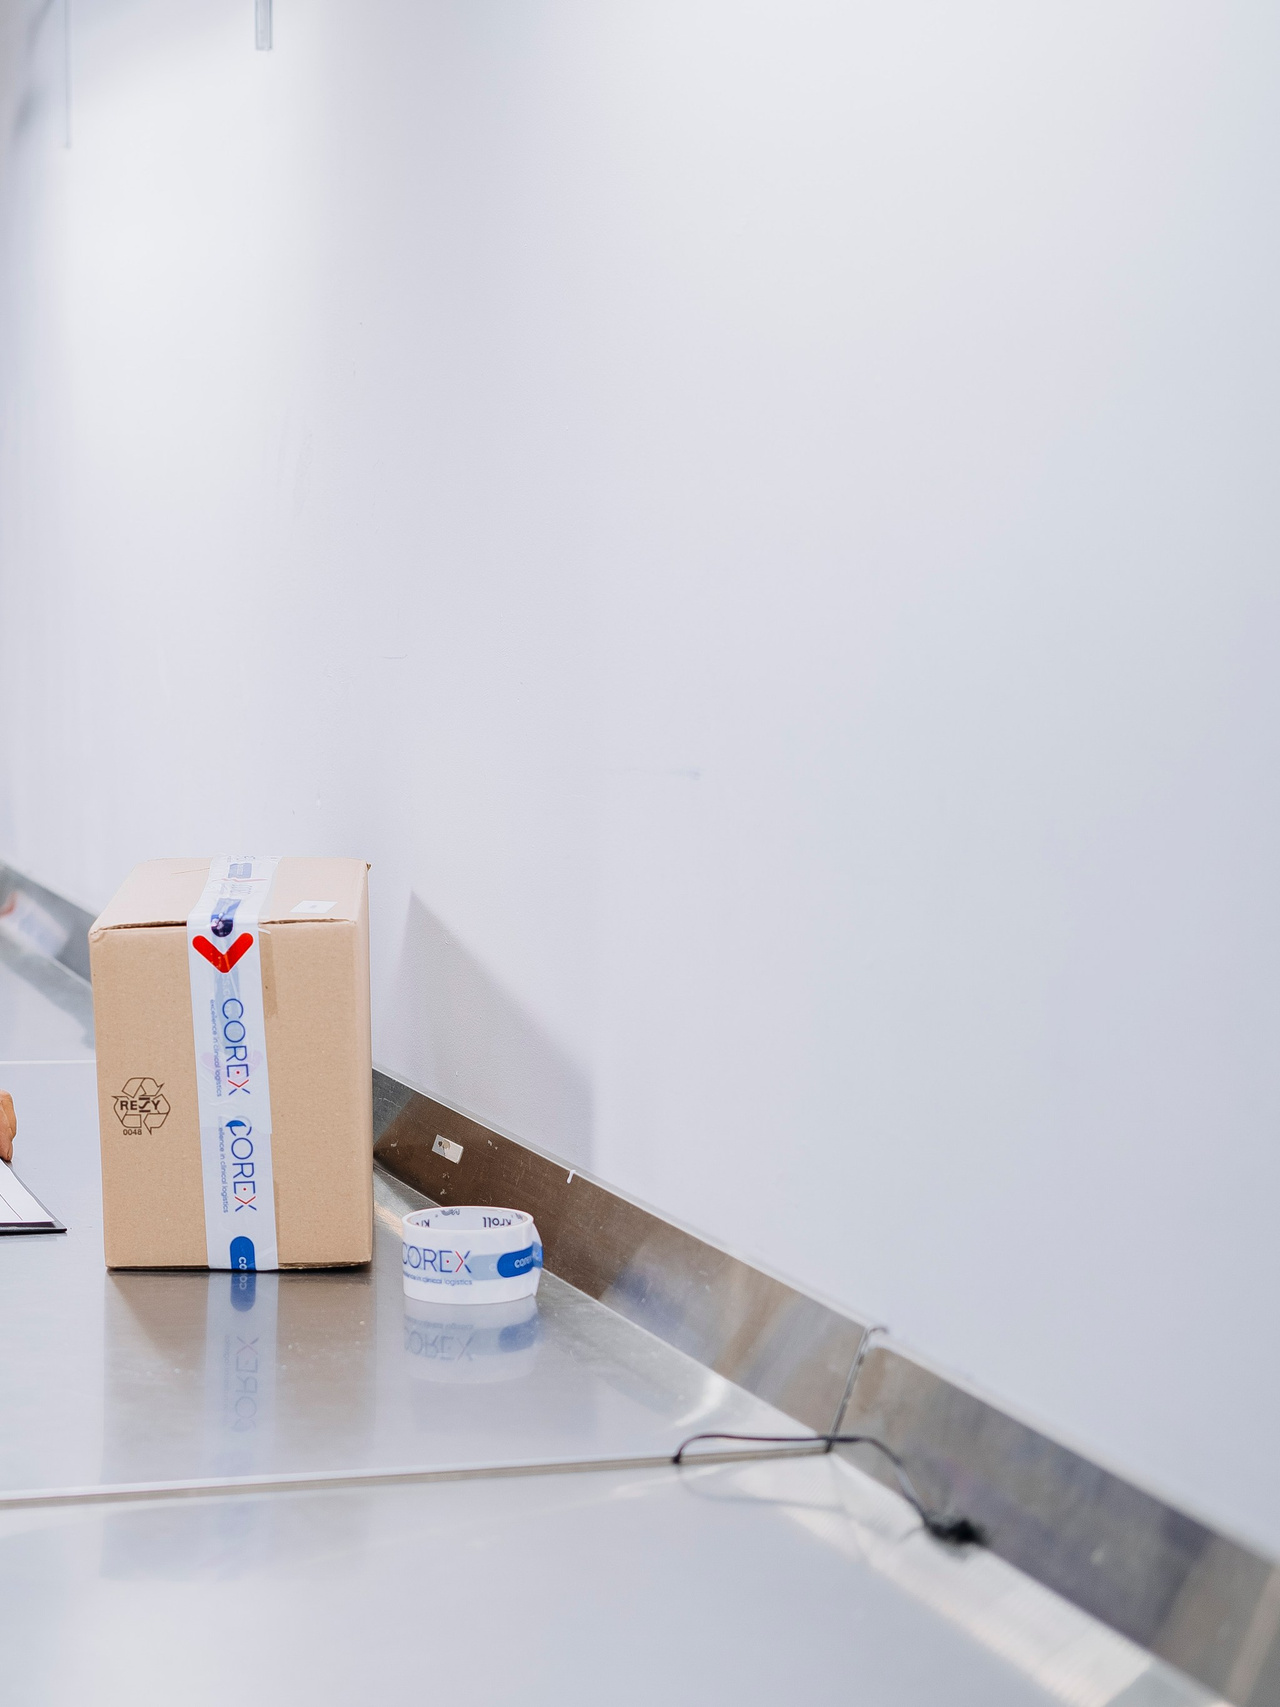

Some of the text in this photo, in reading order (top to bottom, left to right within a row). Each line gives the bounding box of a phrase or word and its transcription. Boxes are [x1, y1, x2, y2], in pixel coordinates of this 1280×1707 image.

[222, 998, 251, 1096] COREX
[214, 1069, 222, 1098] logistics
[122, 1128, 142, 1136] 0048
